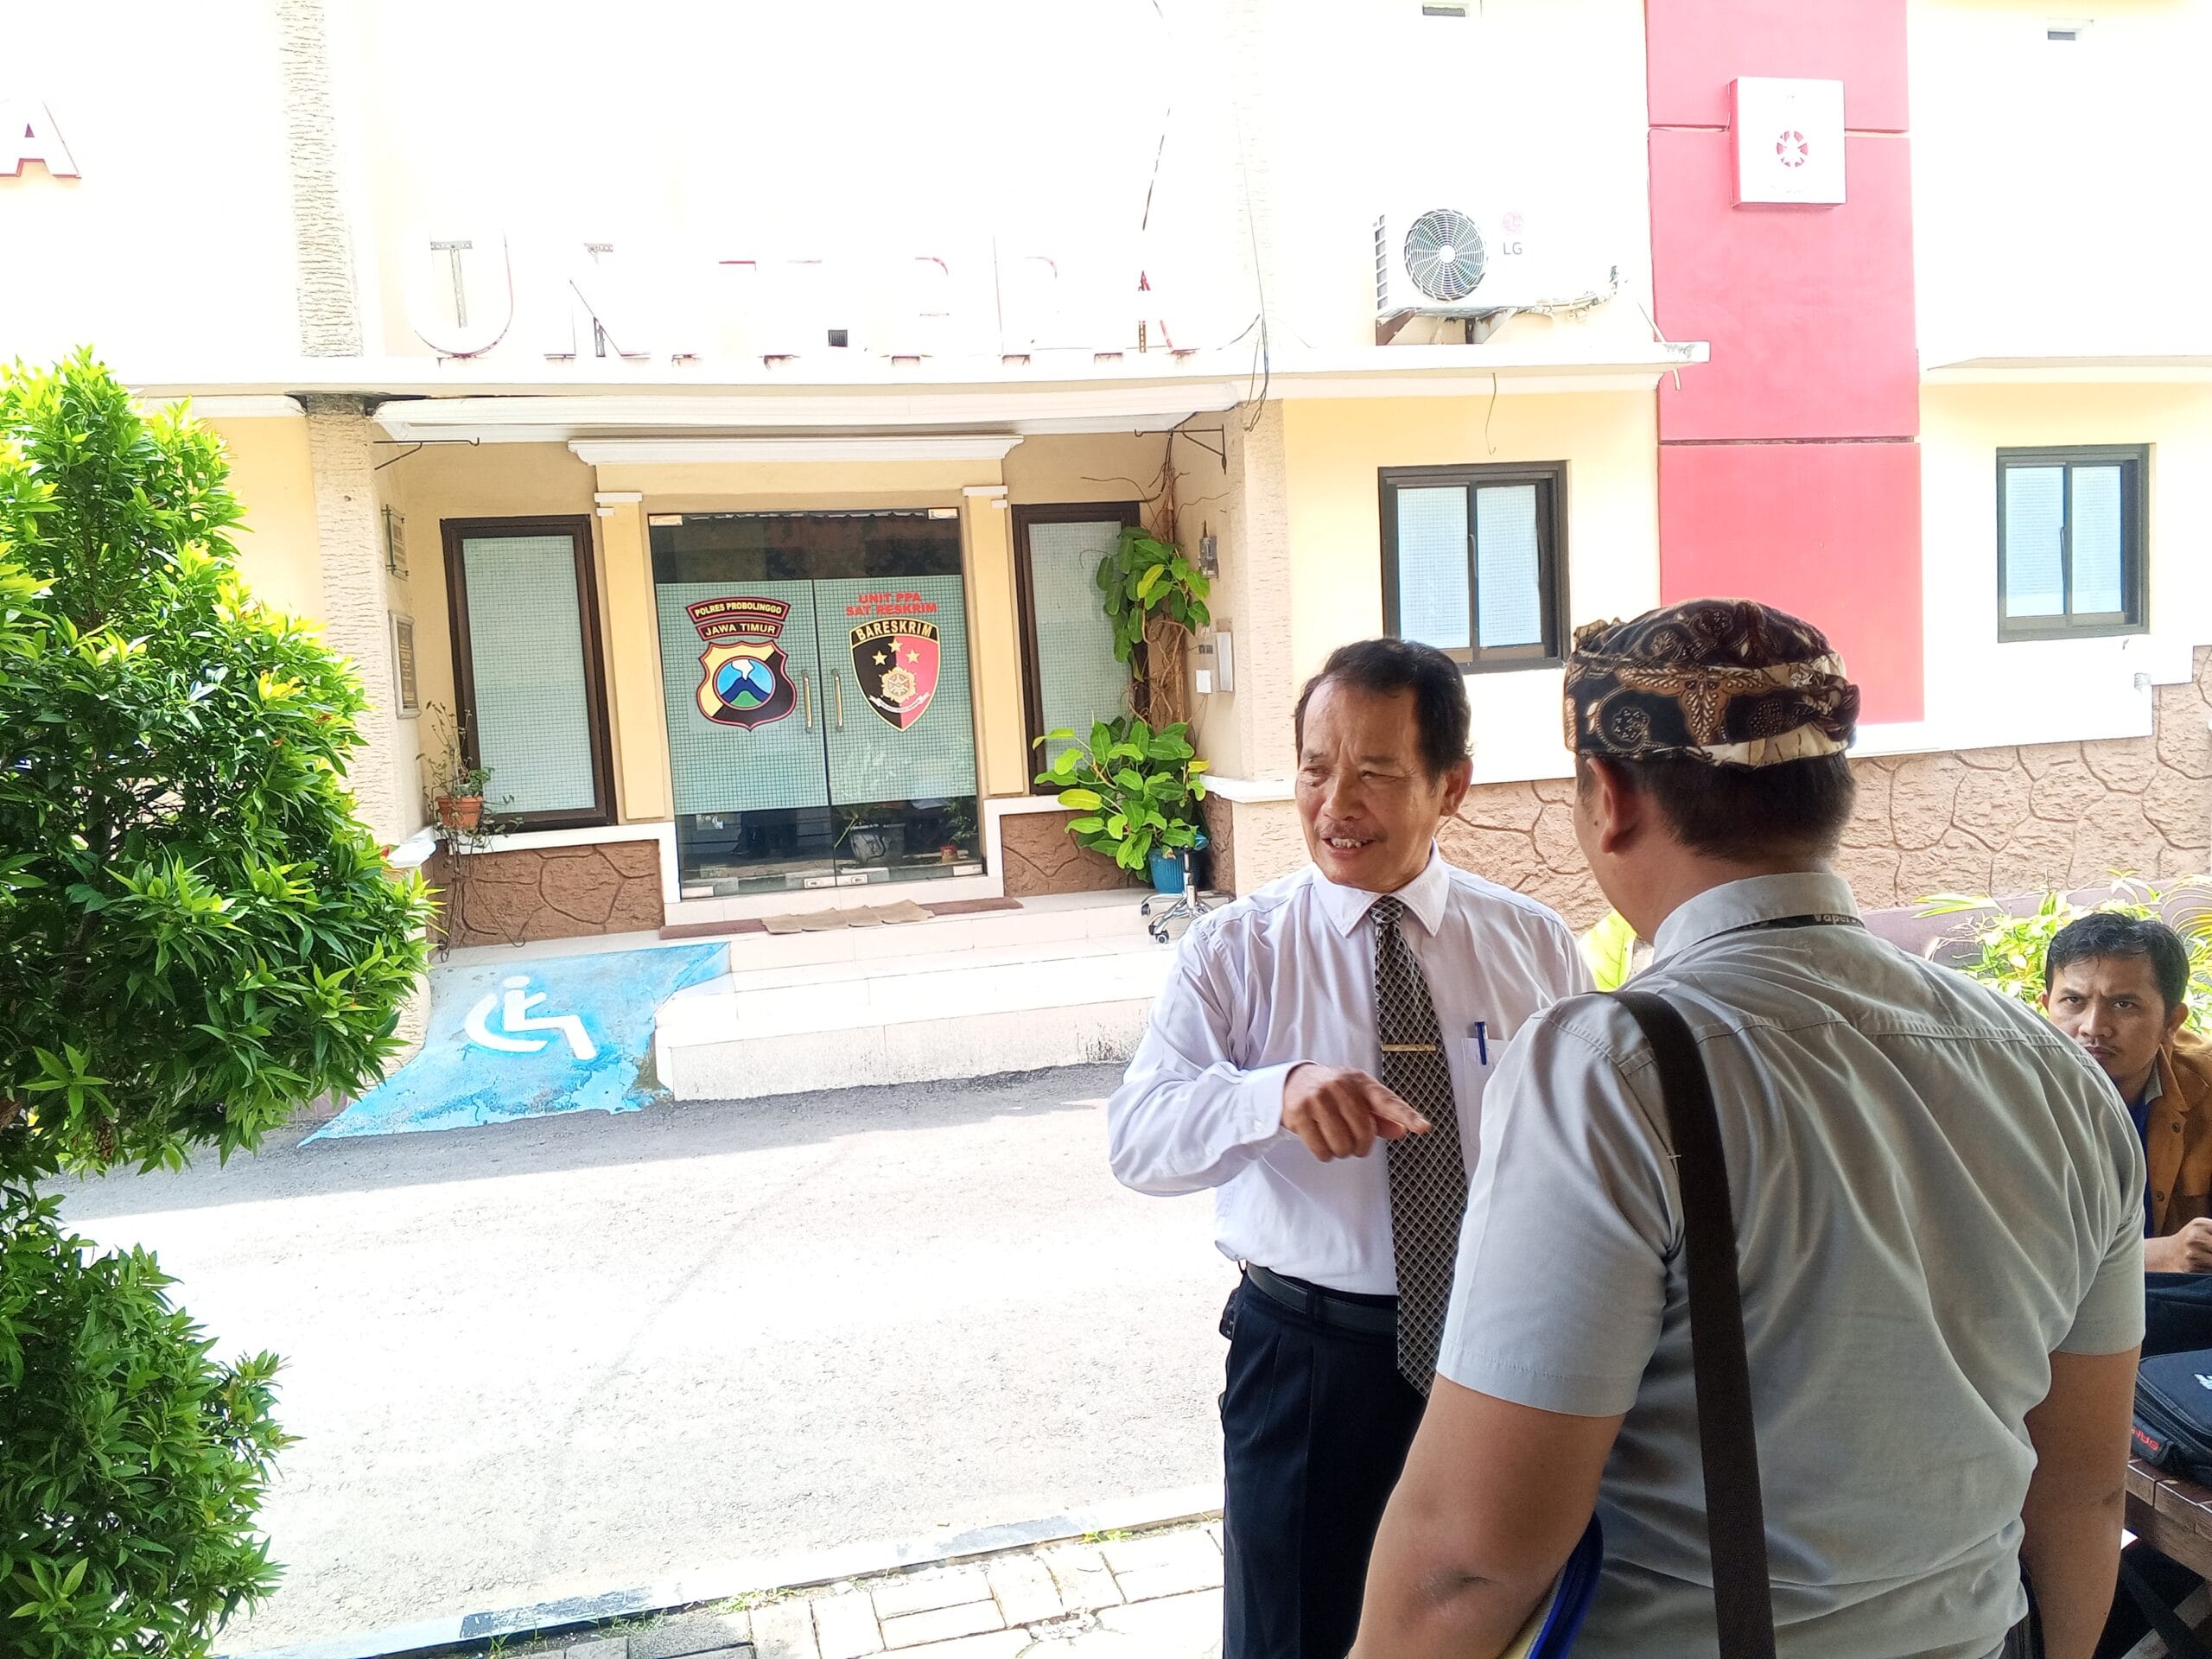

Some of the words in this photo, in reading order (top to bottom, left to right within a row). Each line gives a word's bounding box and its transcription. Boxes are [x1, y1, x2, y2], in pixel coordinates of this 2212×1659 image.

[1503, 241, 1522, 255] LG
[858, 593, 892, 603] UNIT
[896, 591, 922, 602] PPA
[694, 603, 726, 618] POLRES
[726, 601, 783, 614] PROBOLINGGO
[845, 605, 871, 616] SAT
[875, 602, 938, 615] RESKRIM
[704, 623, 737, 637] JAWA
[739, 622, 777, 635] TIMUR
[855, 620, 933, 642] BARESKRIM
